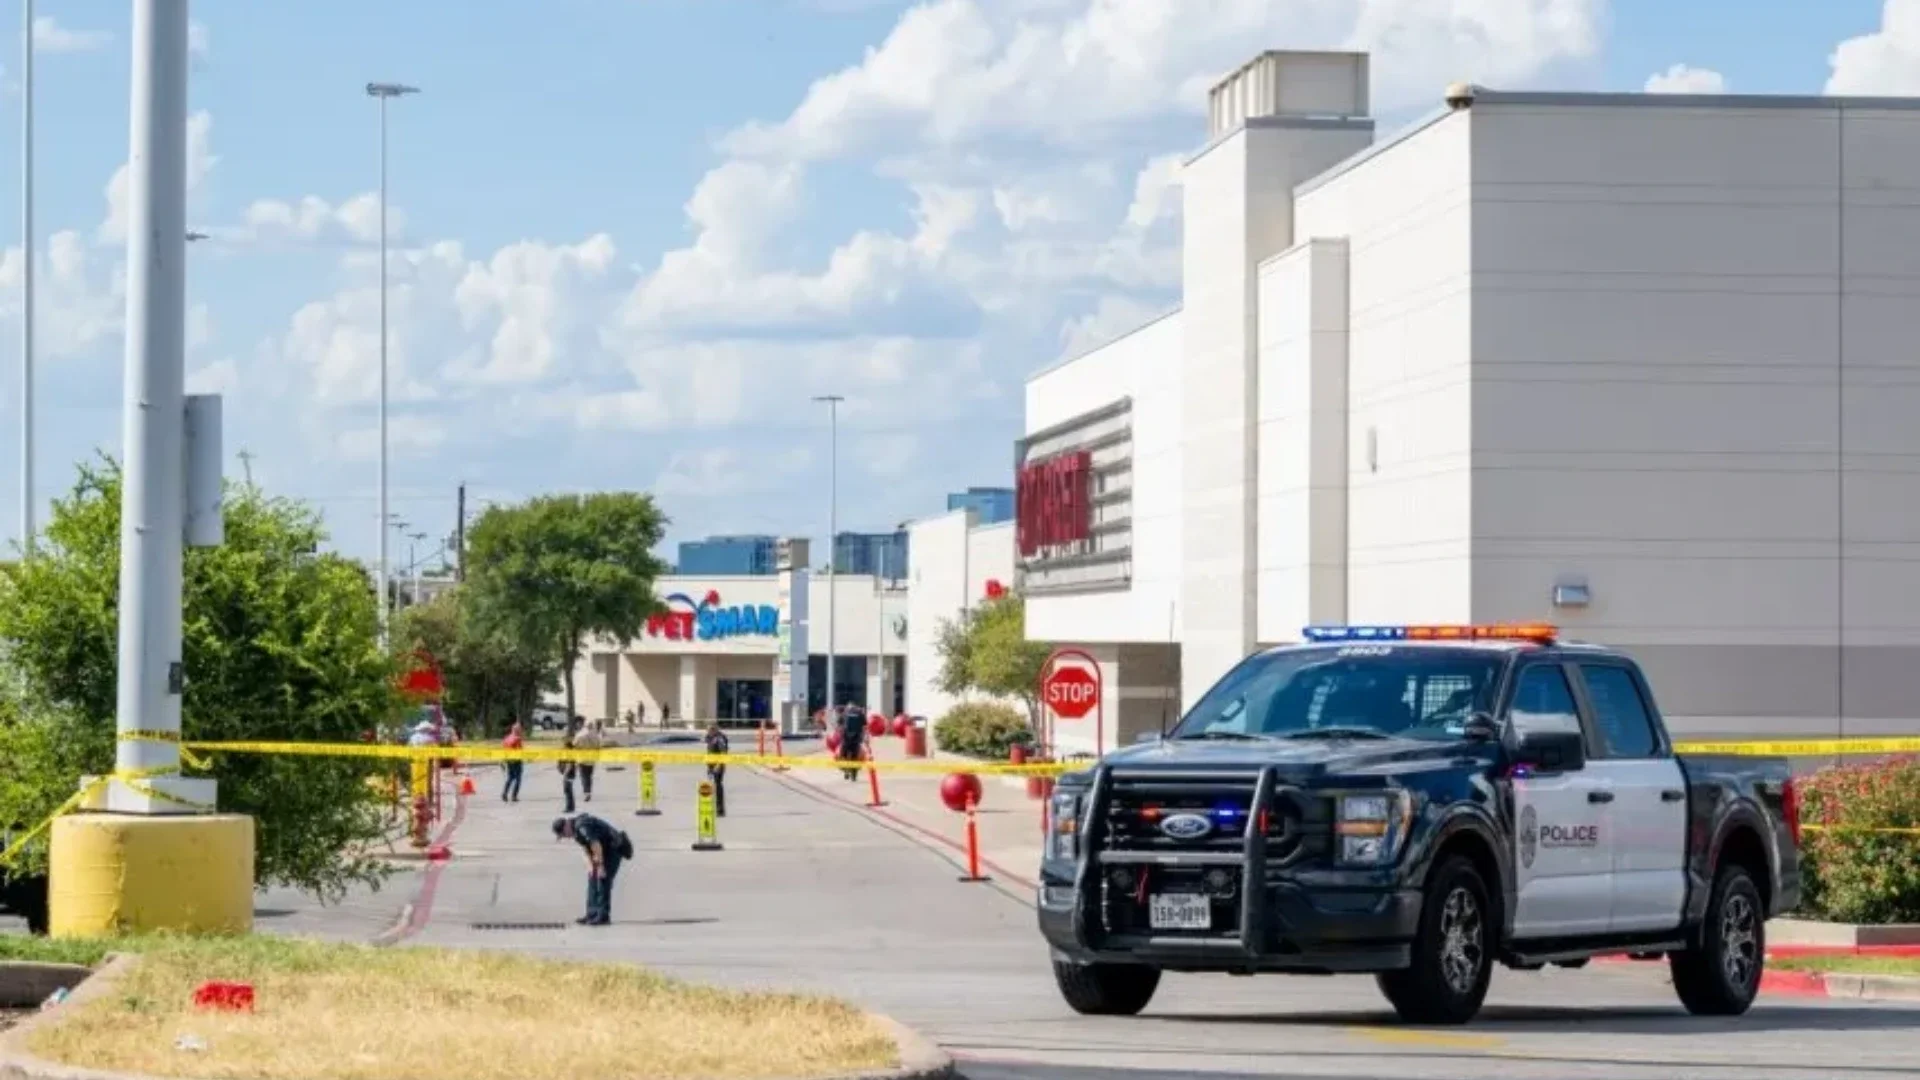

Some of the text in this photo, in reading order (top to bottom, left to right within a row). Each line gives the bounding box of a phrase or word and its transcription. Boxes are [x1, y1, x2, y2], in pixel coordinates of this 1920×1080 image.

[647, 604, 780, 640] PETSMAR
[1049, 682, 1094, 703] STOP
[1540, 825, 1599, 841] POLICE
